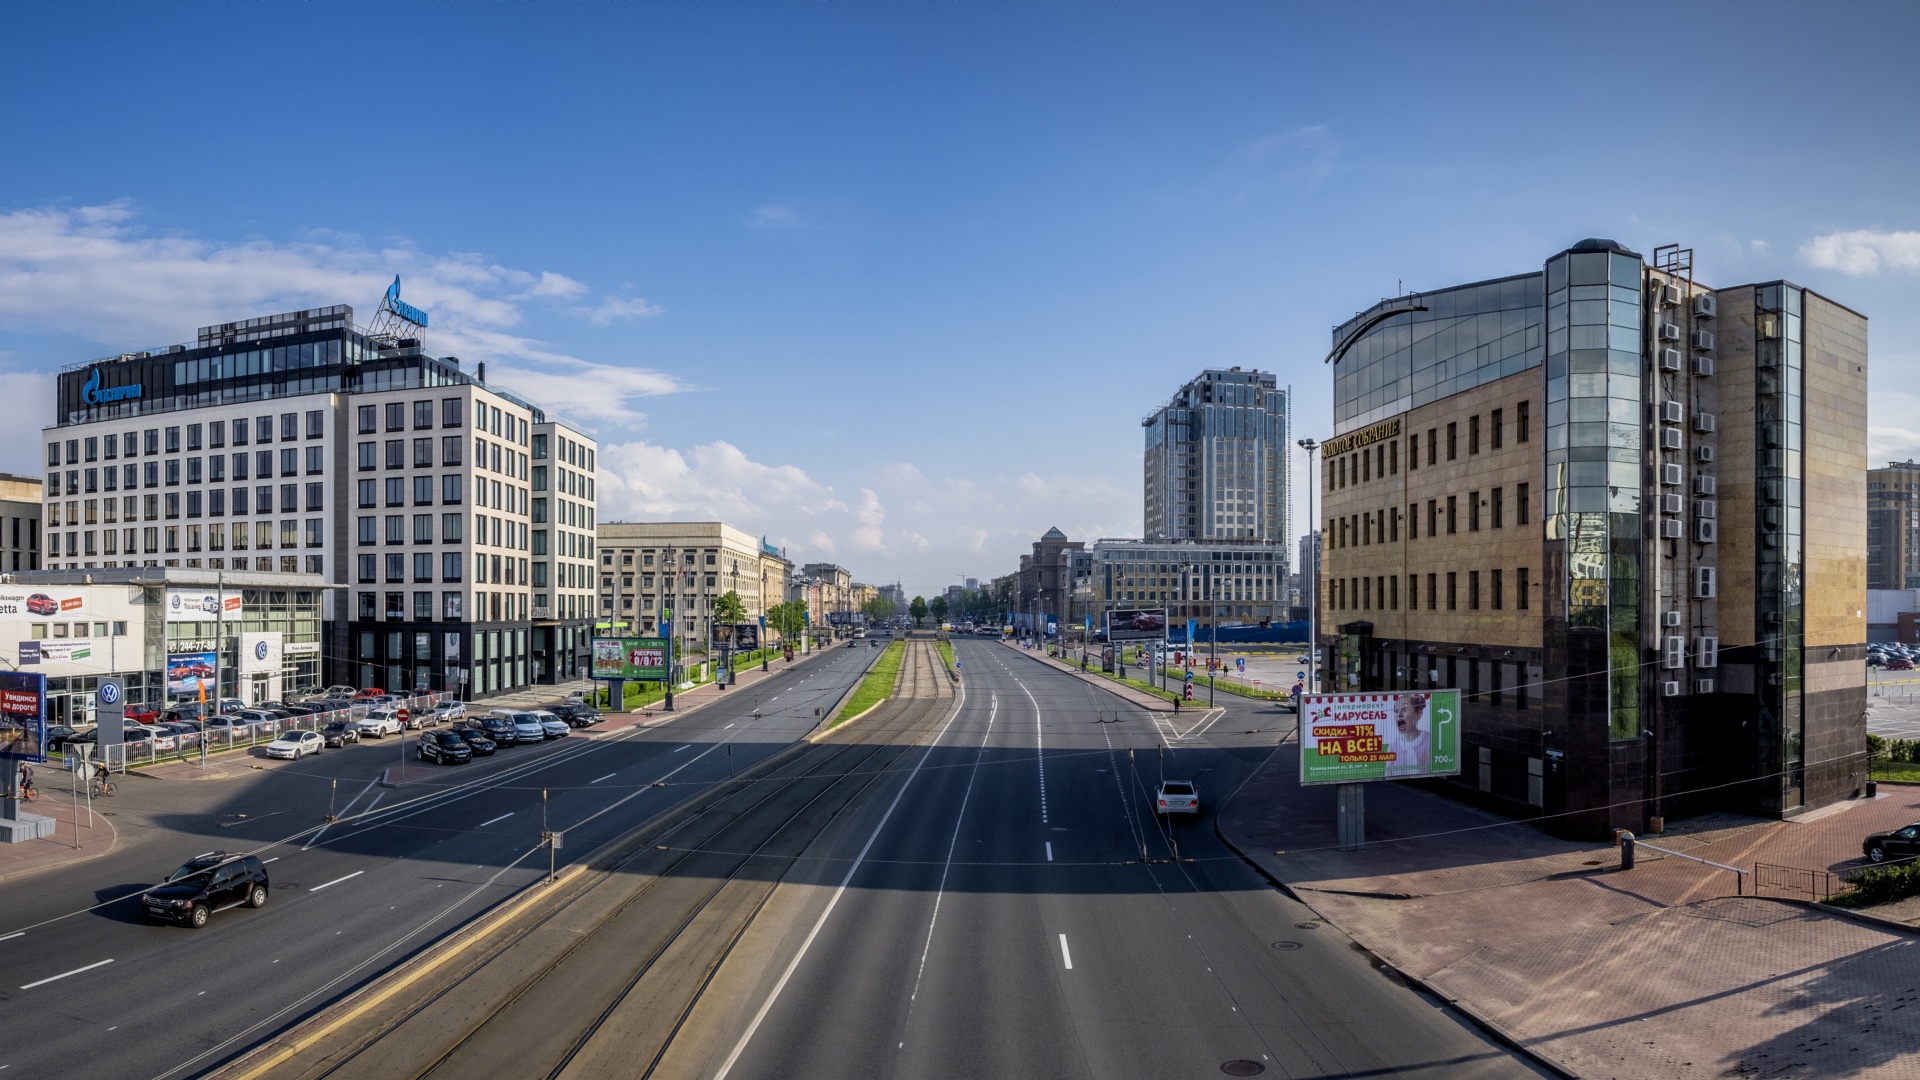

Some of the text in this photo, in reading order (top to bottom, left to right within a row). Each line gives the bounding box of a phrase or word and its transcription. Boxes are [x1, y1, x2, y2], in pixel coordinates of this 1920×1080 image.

[1354, 420, 1400, 448] СОБРАНИЕ
[634, 656, 663, 666] 0/0/12
[5, 692, 36, 703] Увидимся
[11, 703, 36, 711] дороге!
[1334, 710, 1387, 721] КАРУСЕЛЬ
[1313, 727, 1348, 737] СКИДКА
[1320, 741, 1342, 755] НА
[1434, 755, 1448, 763] 700
